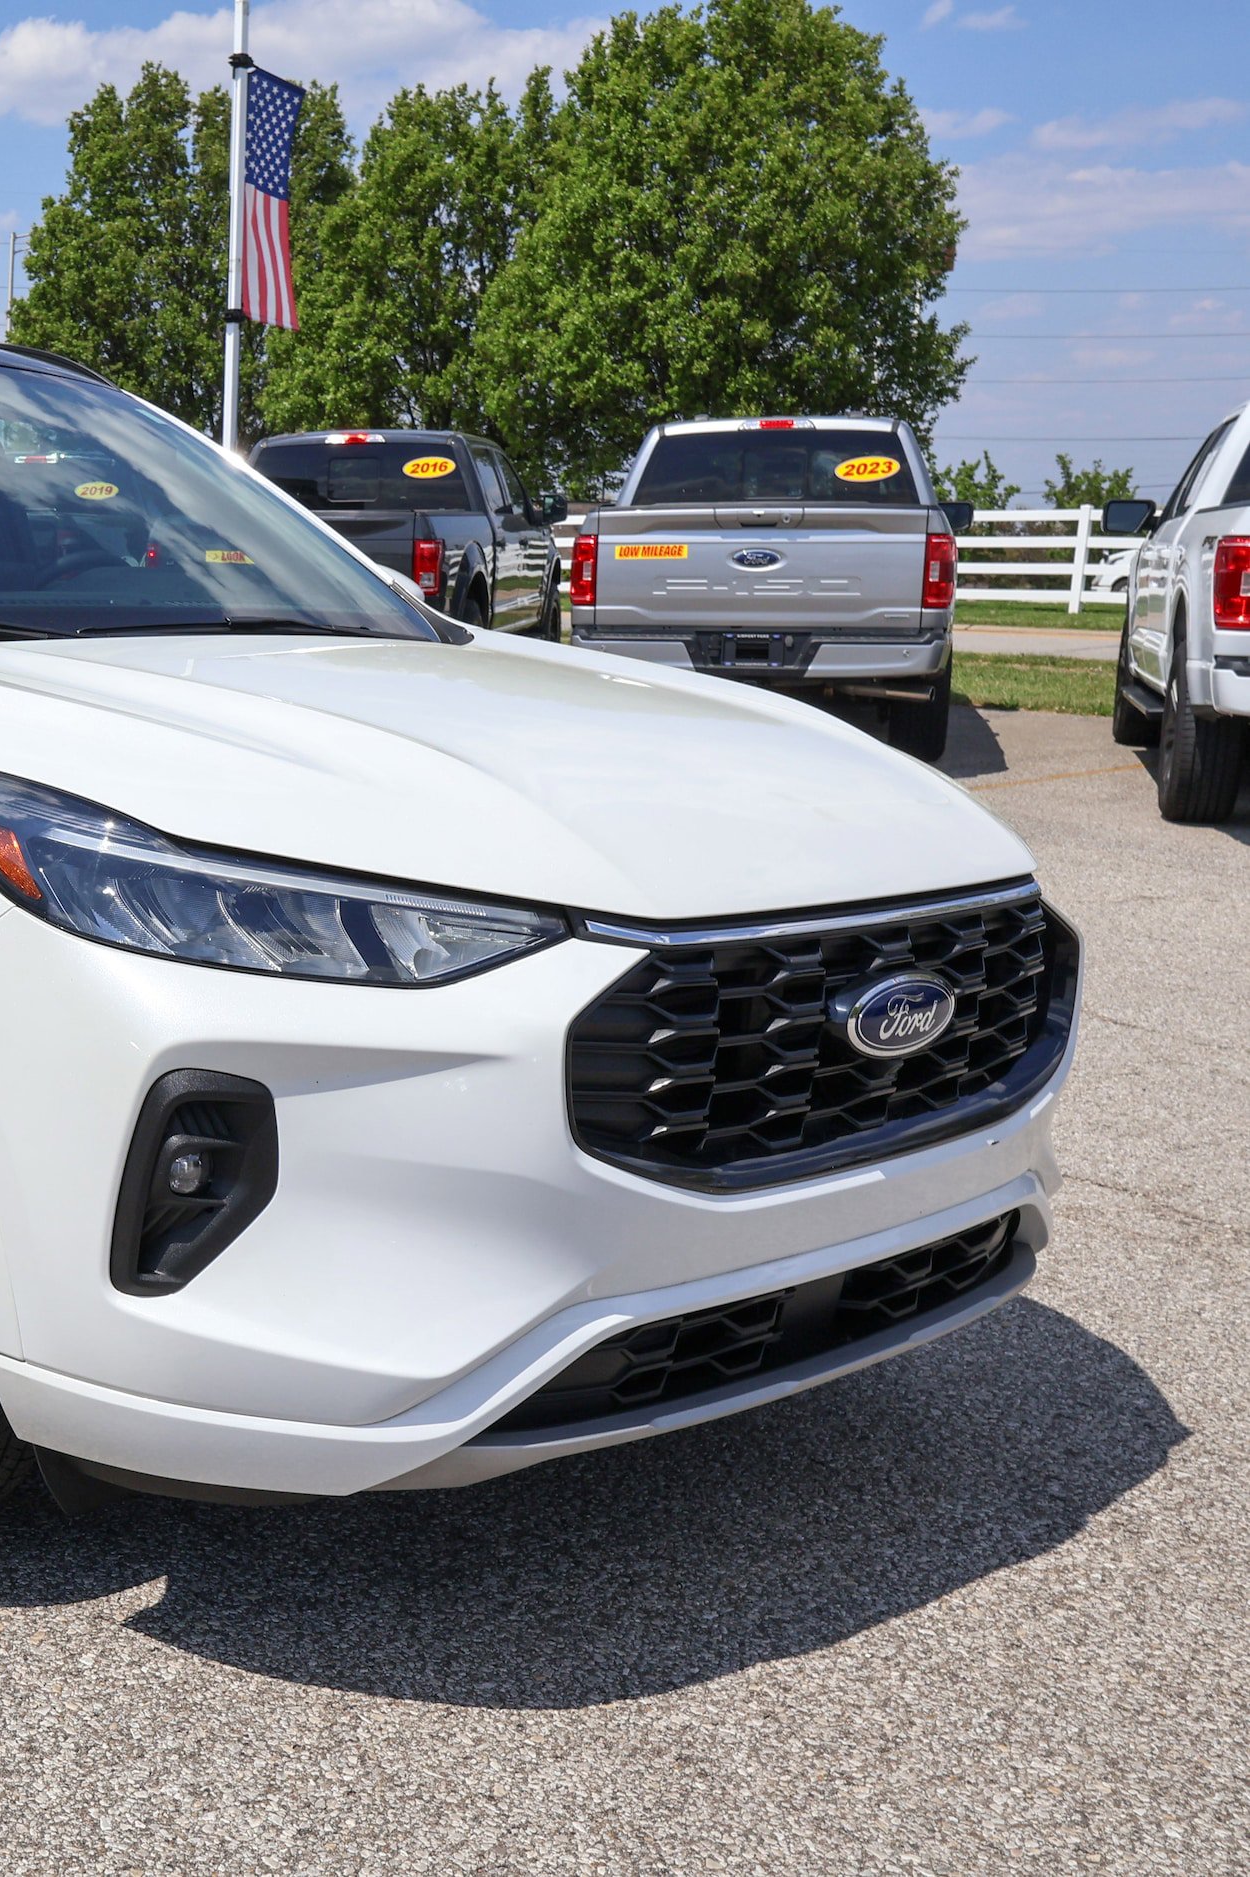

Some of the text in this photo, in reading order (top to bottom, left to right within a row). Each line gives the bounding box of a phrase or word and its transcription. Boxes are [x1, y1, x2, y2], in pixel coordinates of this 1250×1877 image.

[409, 461, 449, 474] 2016
[842, 461, 893, 477] 2023
[80, 485, 114, 496] 2019
[618, 545, 684, 557] LOW MILEAGE
[879, 991, 939, 1041] Ford
